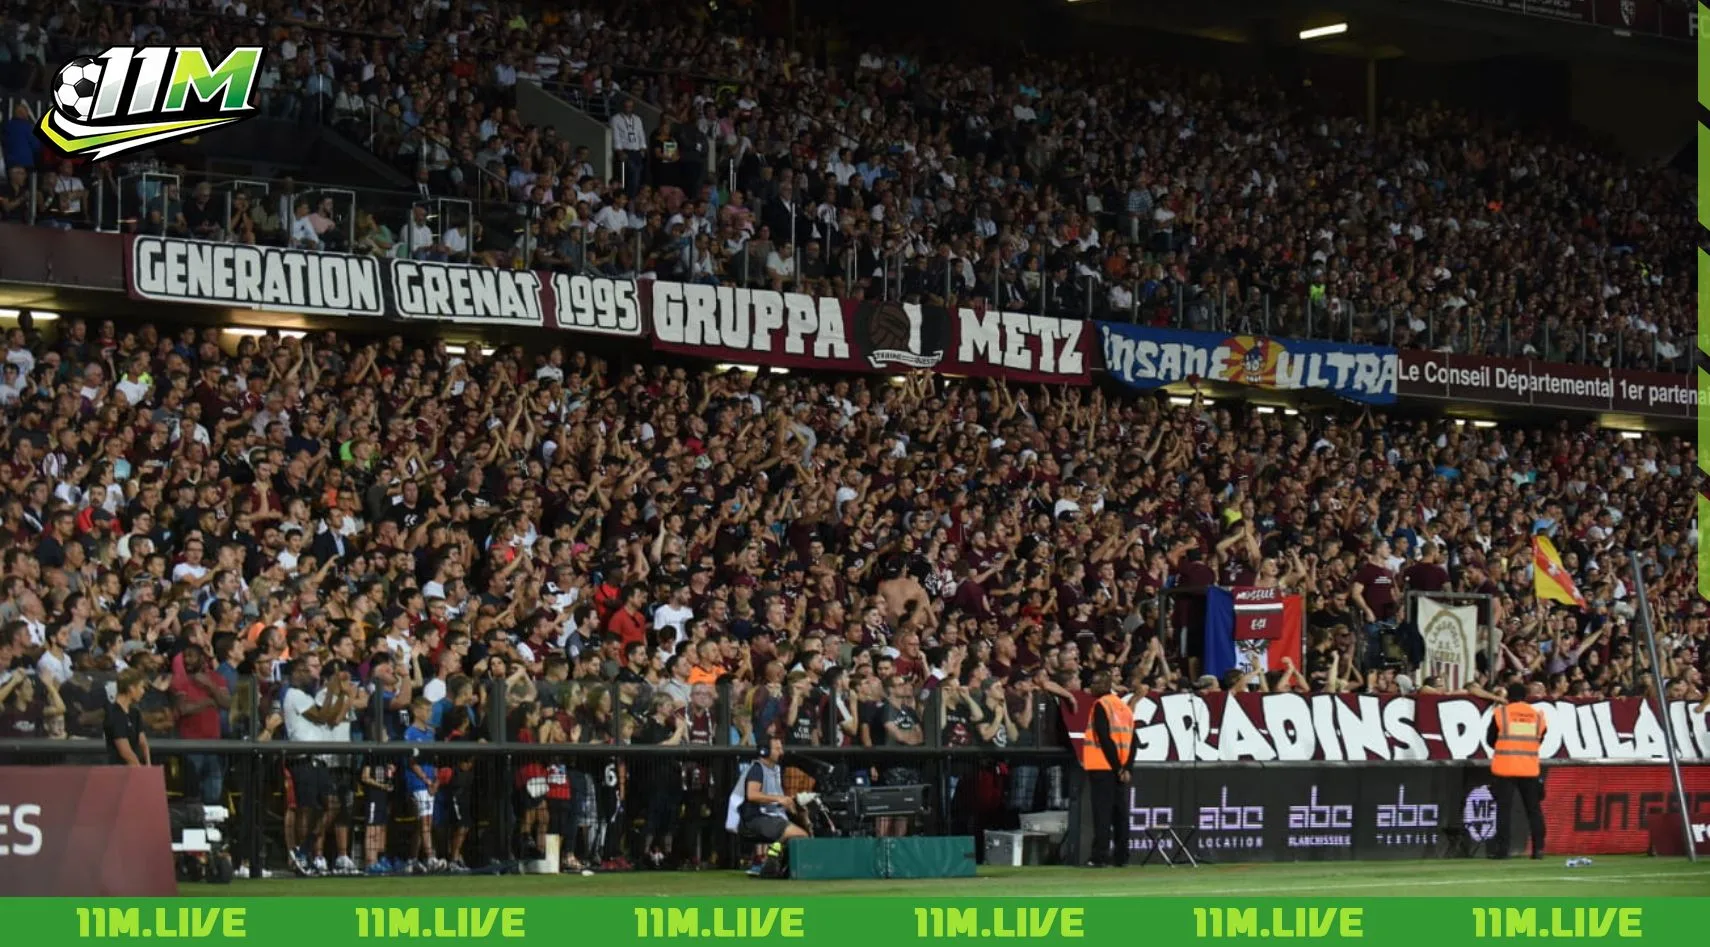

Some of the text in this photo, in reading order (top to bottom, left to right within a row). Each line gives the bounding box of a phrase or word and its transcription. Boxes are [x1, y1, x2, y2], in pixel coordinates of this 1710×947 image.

[139, 240, 638, 331] GENERATION GRENAT 1995
[653, 281, 849, 358] GRUPPA
[958, 307, 1083, 374] METZ
[1276, 350, 1398, 394] ULTRA
[1398, 359, 1420, 382] Le
[1424, 361, 1490, 388] Conseil
[1495, 367, 1614, 398] Départemental
[1619, 379, 1645, 400] 1er
[1123, 692, 1429, 761] GRADINS
[604, 763, 618, 787] 6
[1128, 786, 1173, 831] bc
[1199, 784, 1264, 830] abc
[1288, 784, 1353, 829] abc
[1376, 784, 1439, 827] abc
[1198, 836, 1264, 849] LOCATION
